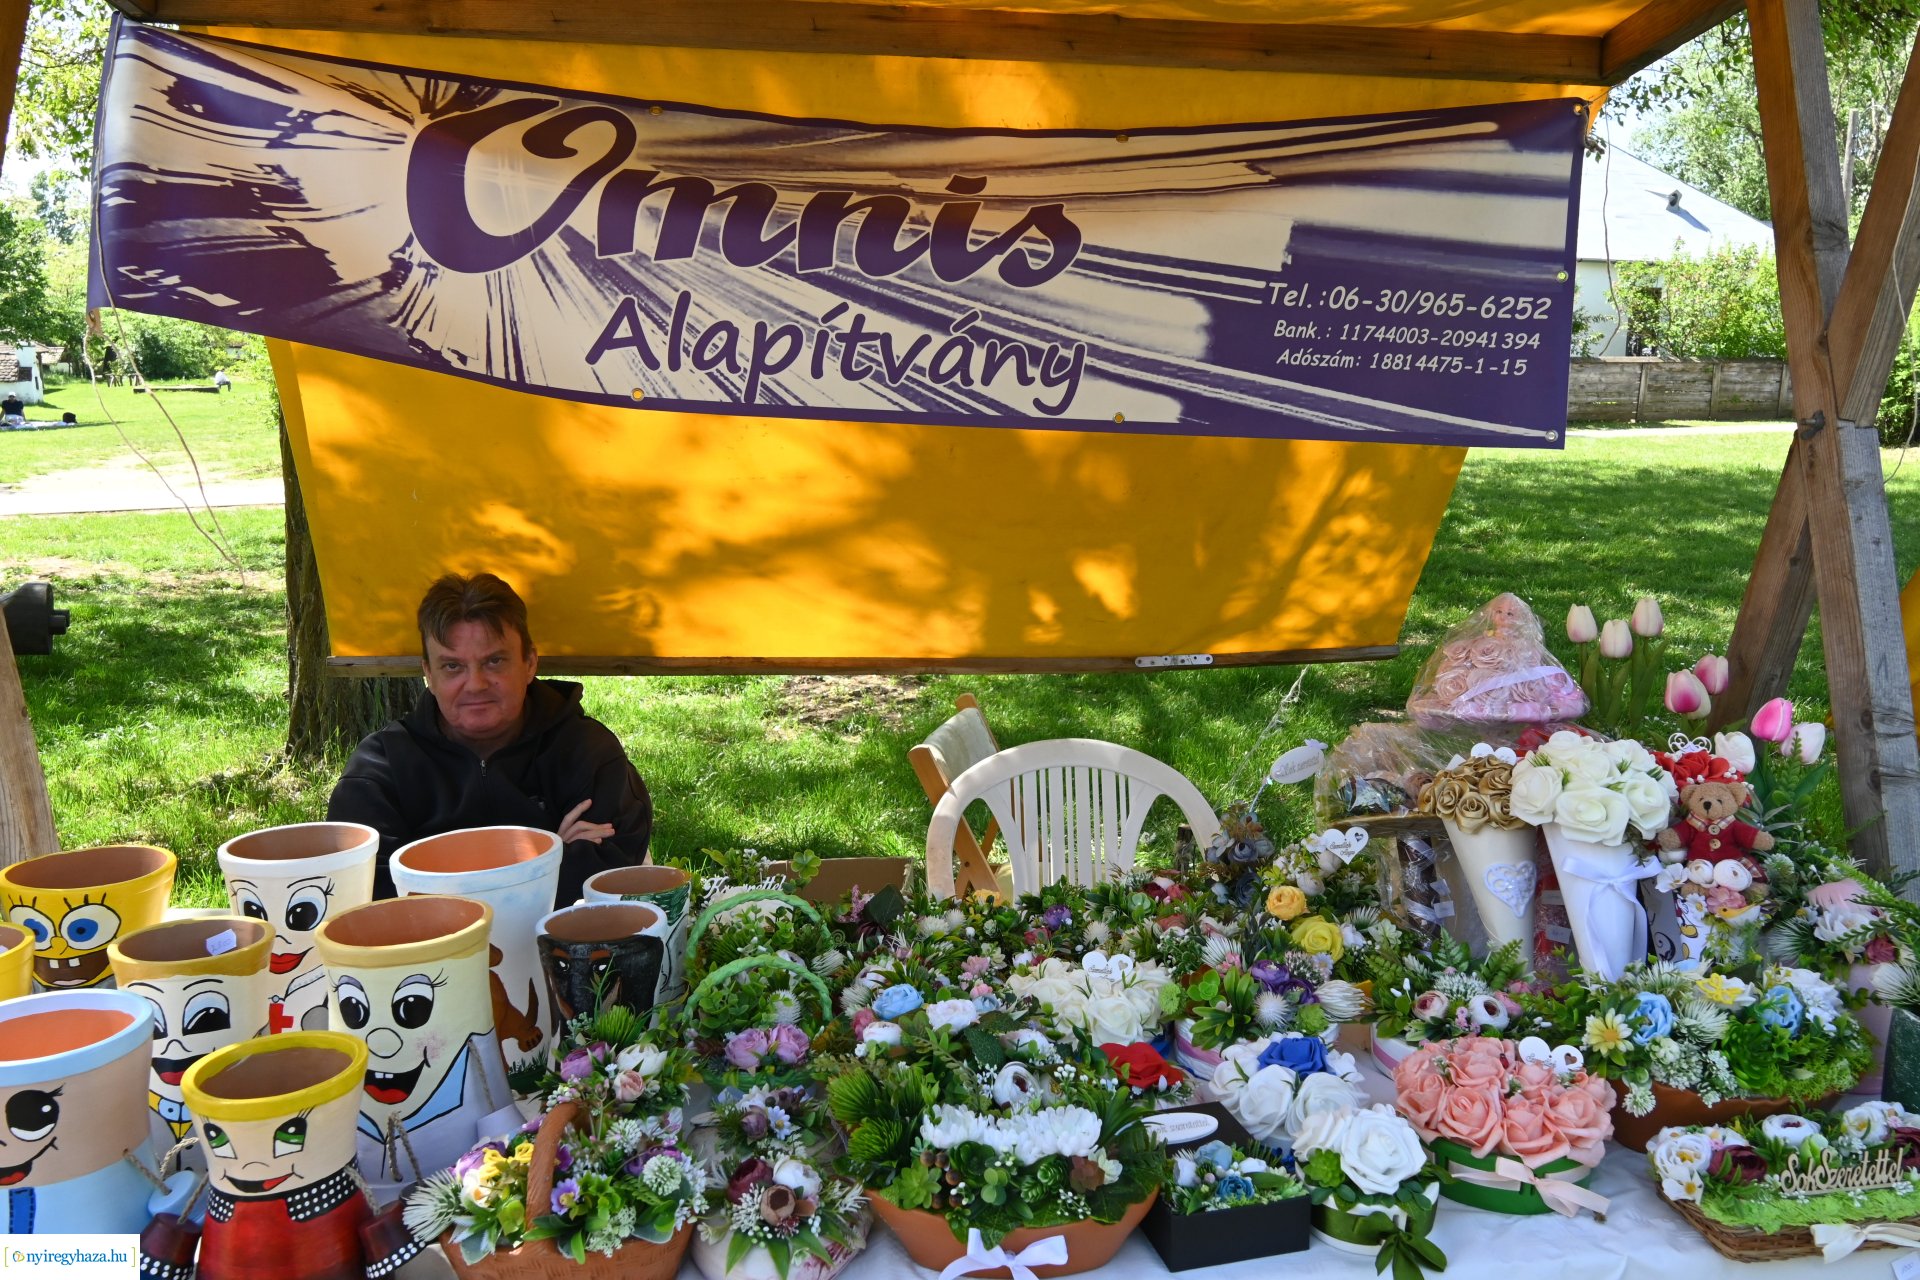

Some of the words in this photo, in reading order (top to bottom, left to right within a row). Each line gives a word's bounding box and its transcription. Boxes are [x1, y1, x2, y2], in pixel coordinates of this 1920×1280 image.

[406, 98, 1081, 287] Omnis
[586, 291, 1086, 415] Alapítvány
[1276, 348, 1361, 368] Adószám:
[1370, 352, 1528, 376] 18814475-1-15
[1340, 323, 1540, 349] 11744003-20941394
